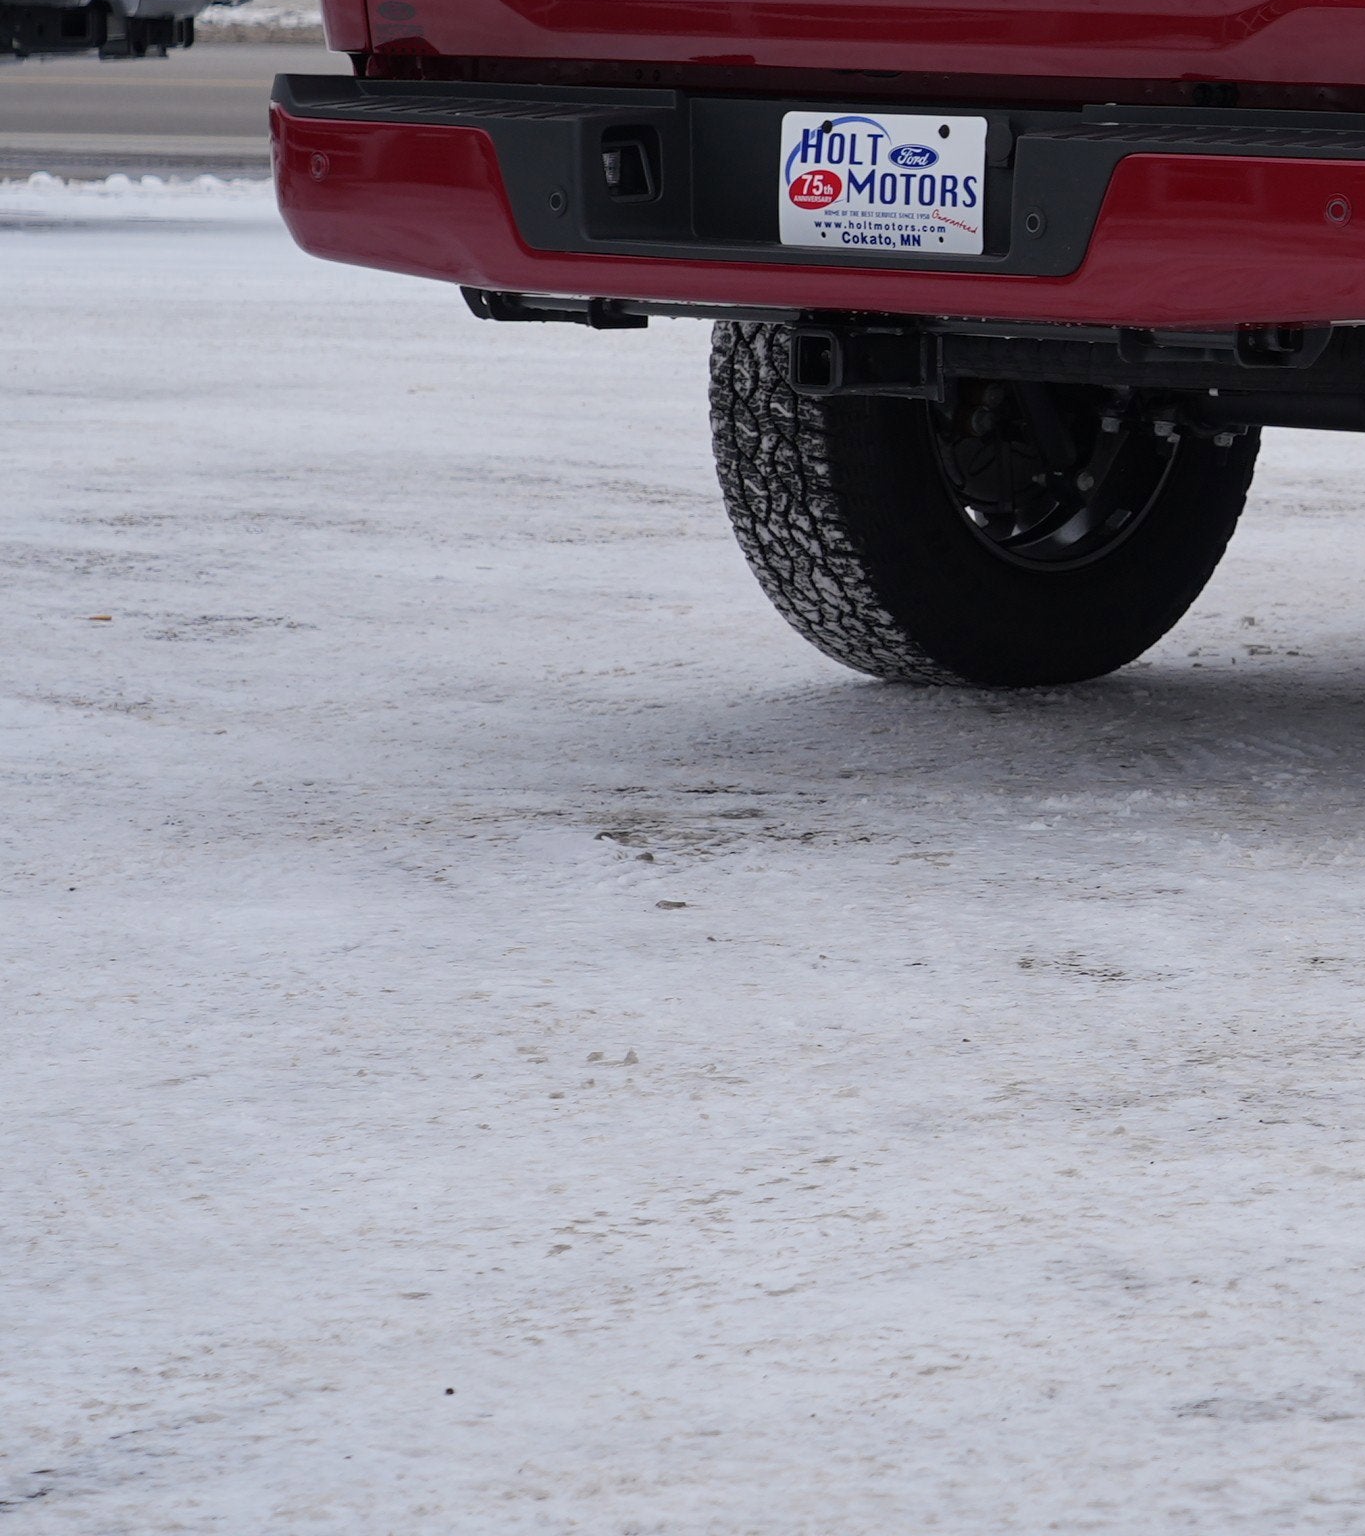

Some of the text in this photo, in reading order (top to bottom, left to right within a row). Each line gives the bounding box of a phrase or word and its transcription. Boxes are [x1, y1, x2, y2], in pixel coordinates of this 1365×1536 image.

[800, 128, 884, 166] HOLT
[897, 147, 929, 166] Ford
[801, 174, 834, 196] 75th
[847, 168, 978, 208] MOTORS
[793, 195, 833, 203] ANNIVERSARY
[814, 220, 946, 233] www.holtmotors.com
[931, 209, 979, 235] Guaranteed
[841, 231, 921, 248] Cokato, MN
